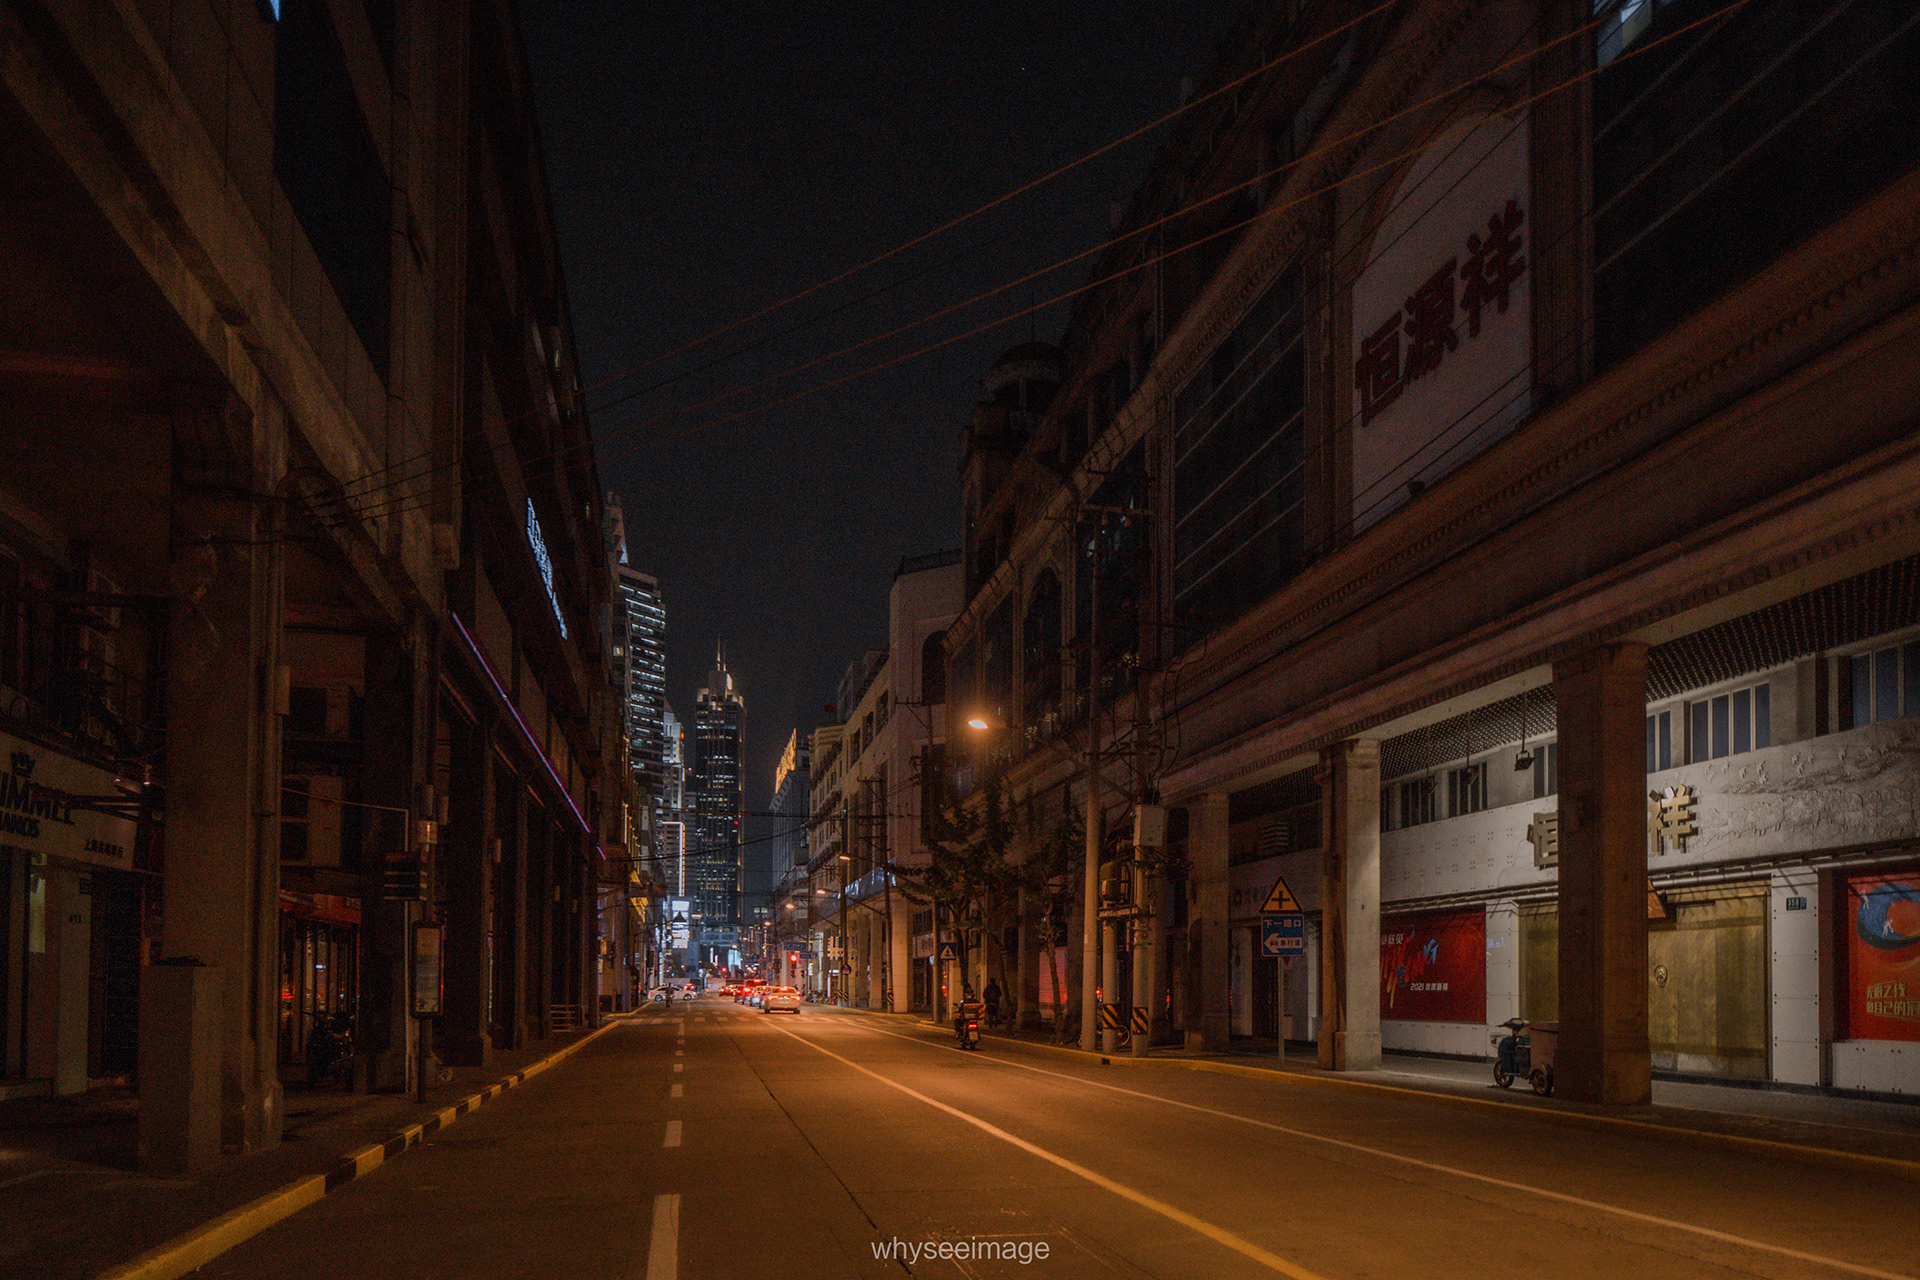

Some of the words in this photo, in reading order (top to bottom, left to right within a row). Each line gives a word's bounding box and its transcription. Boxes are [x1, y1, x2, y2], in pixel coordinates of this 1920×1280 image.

[1354, 198, 1526, 428] 恒源祥
[1263, 918, 1302, 929] 下一路口
[1410, 982, 1424, 991] 2021
